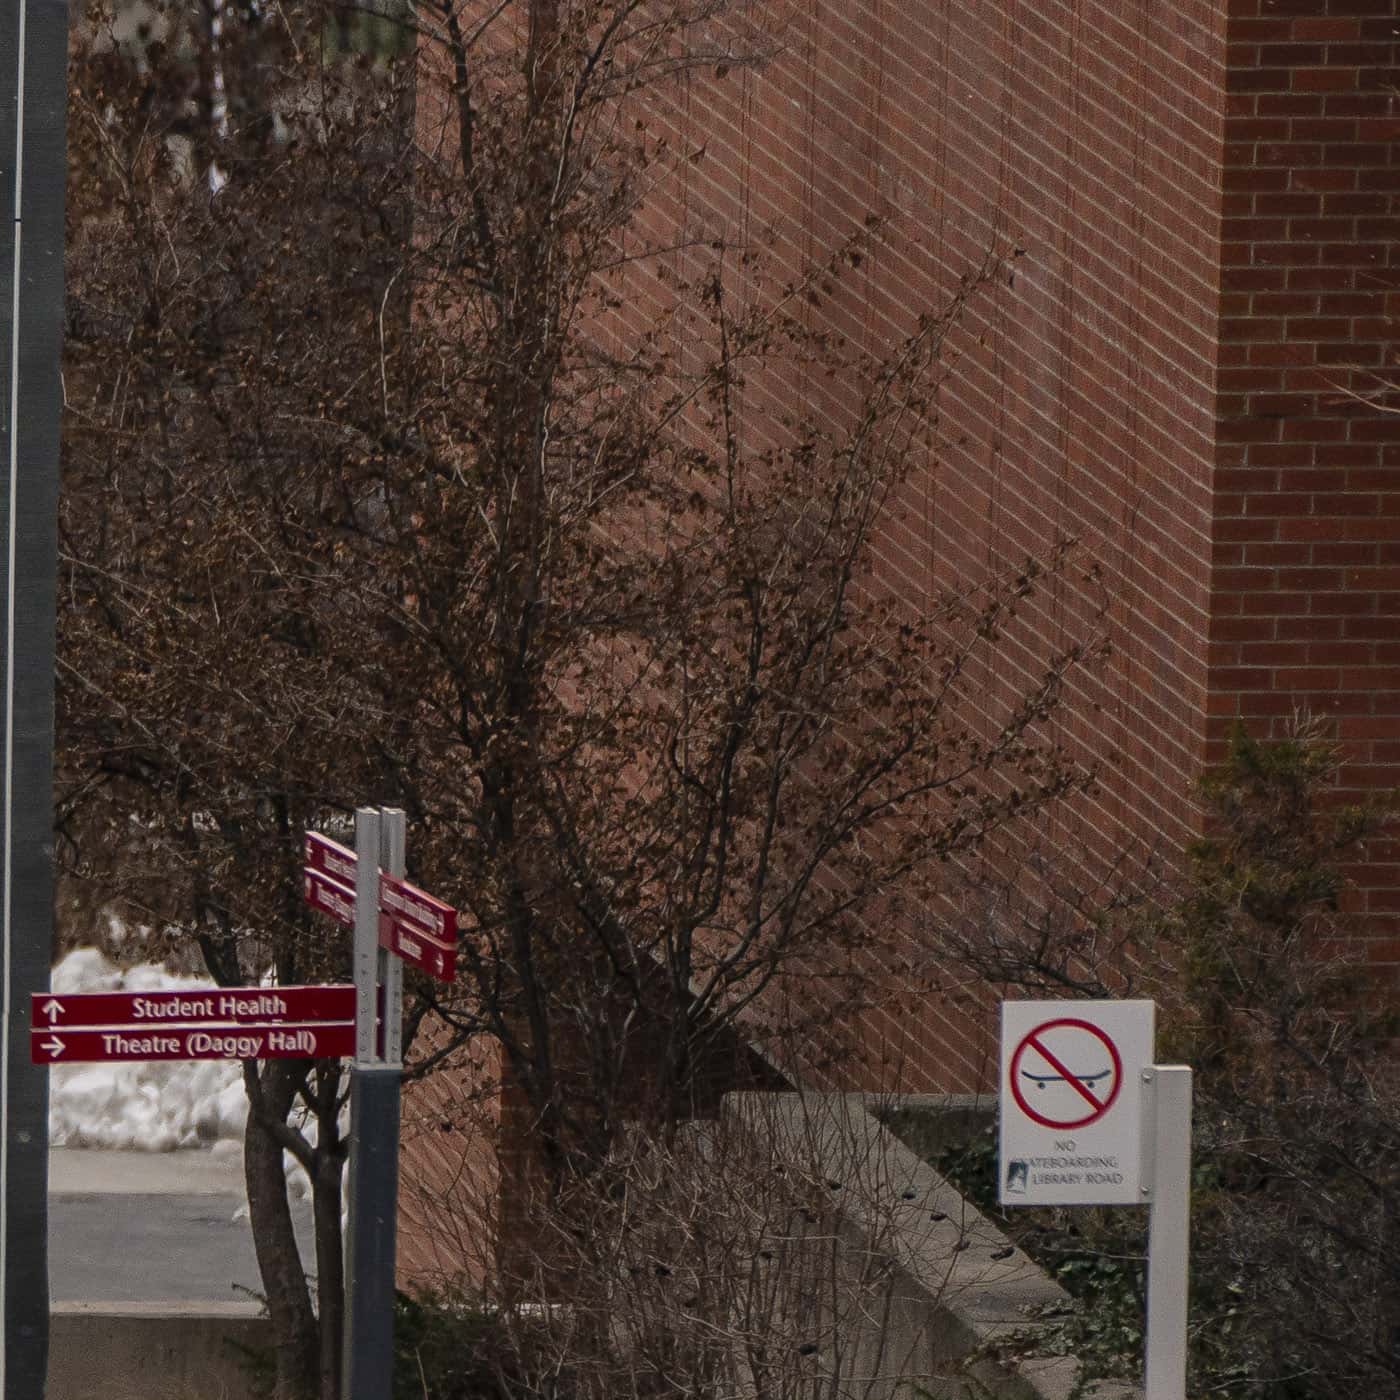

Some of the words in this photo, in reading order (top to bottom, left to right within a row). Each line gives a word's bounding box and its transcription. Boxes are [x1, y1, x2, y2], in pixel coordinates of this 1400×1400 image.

[132, 998, 215, 1018] Student
[219, 996, 287, 1016] Health
[101, 1033, 181, 1054] Theatre
[186, 1031, 263, 1058] (Daggy
[268, 1031, 317, 1054] Hall)
[1055, 1139, 1076, 1152] NO
[1028, 1157, 1120, 1169] ATEBOARDING
[1033, 1173, 1081, 1185] LIBRARY
[1085, 1172, 1124, 1185] ROAD
